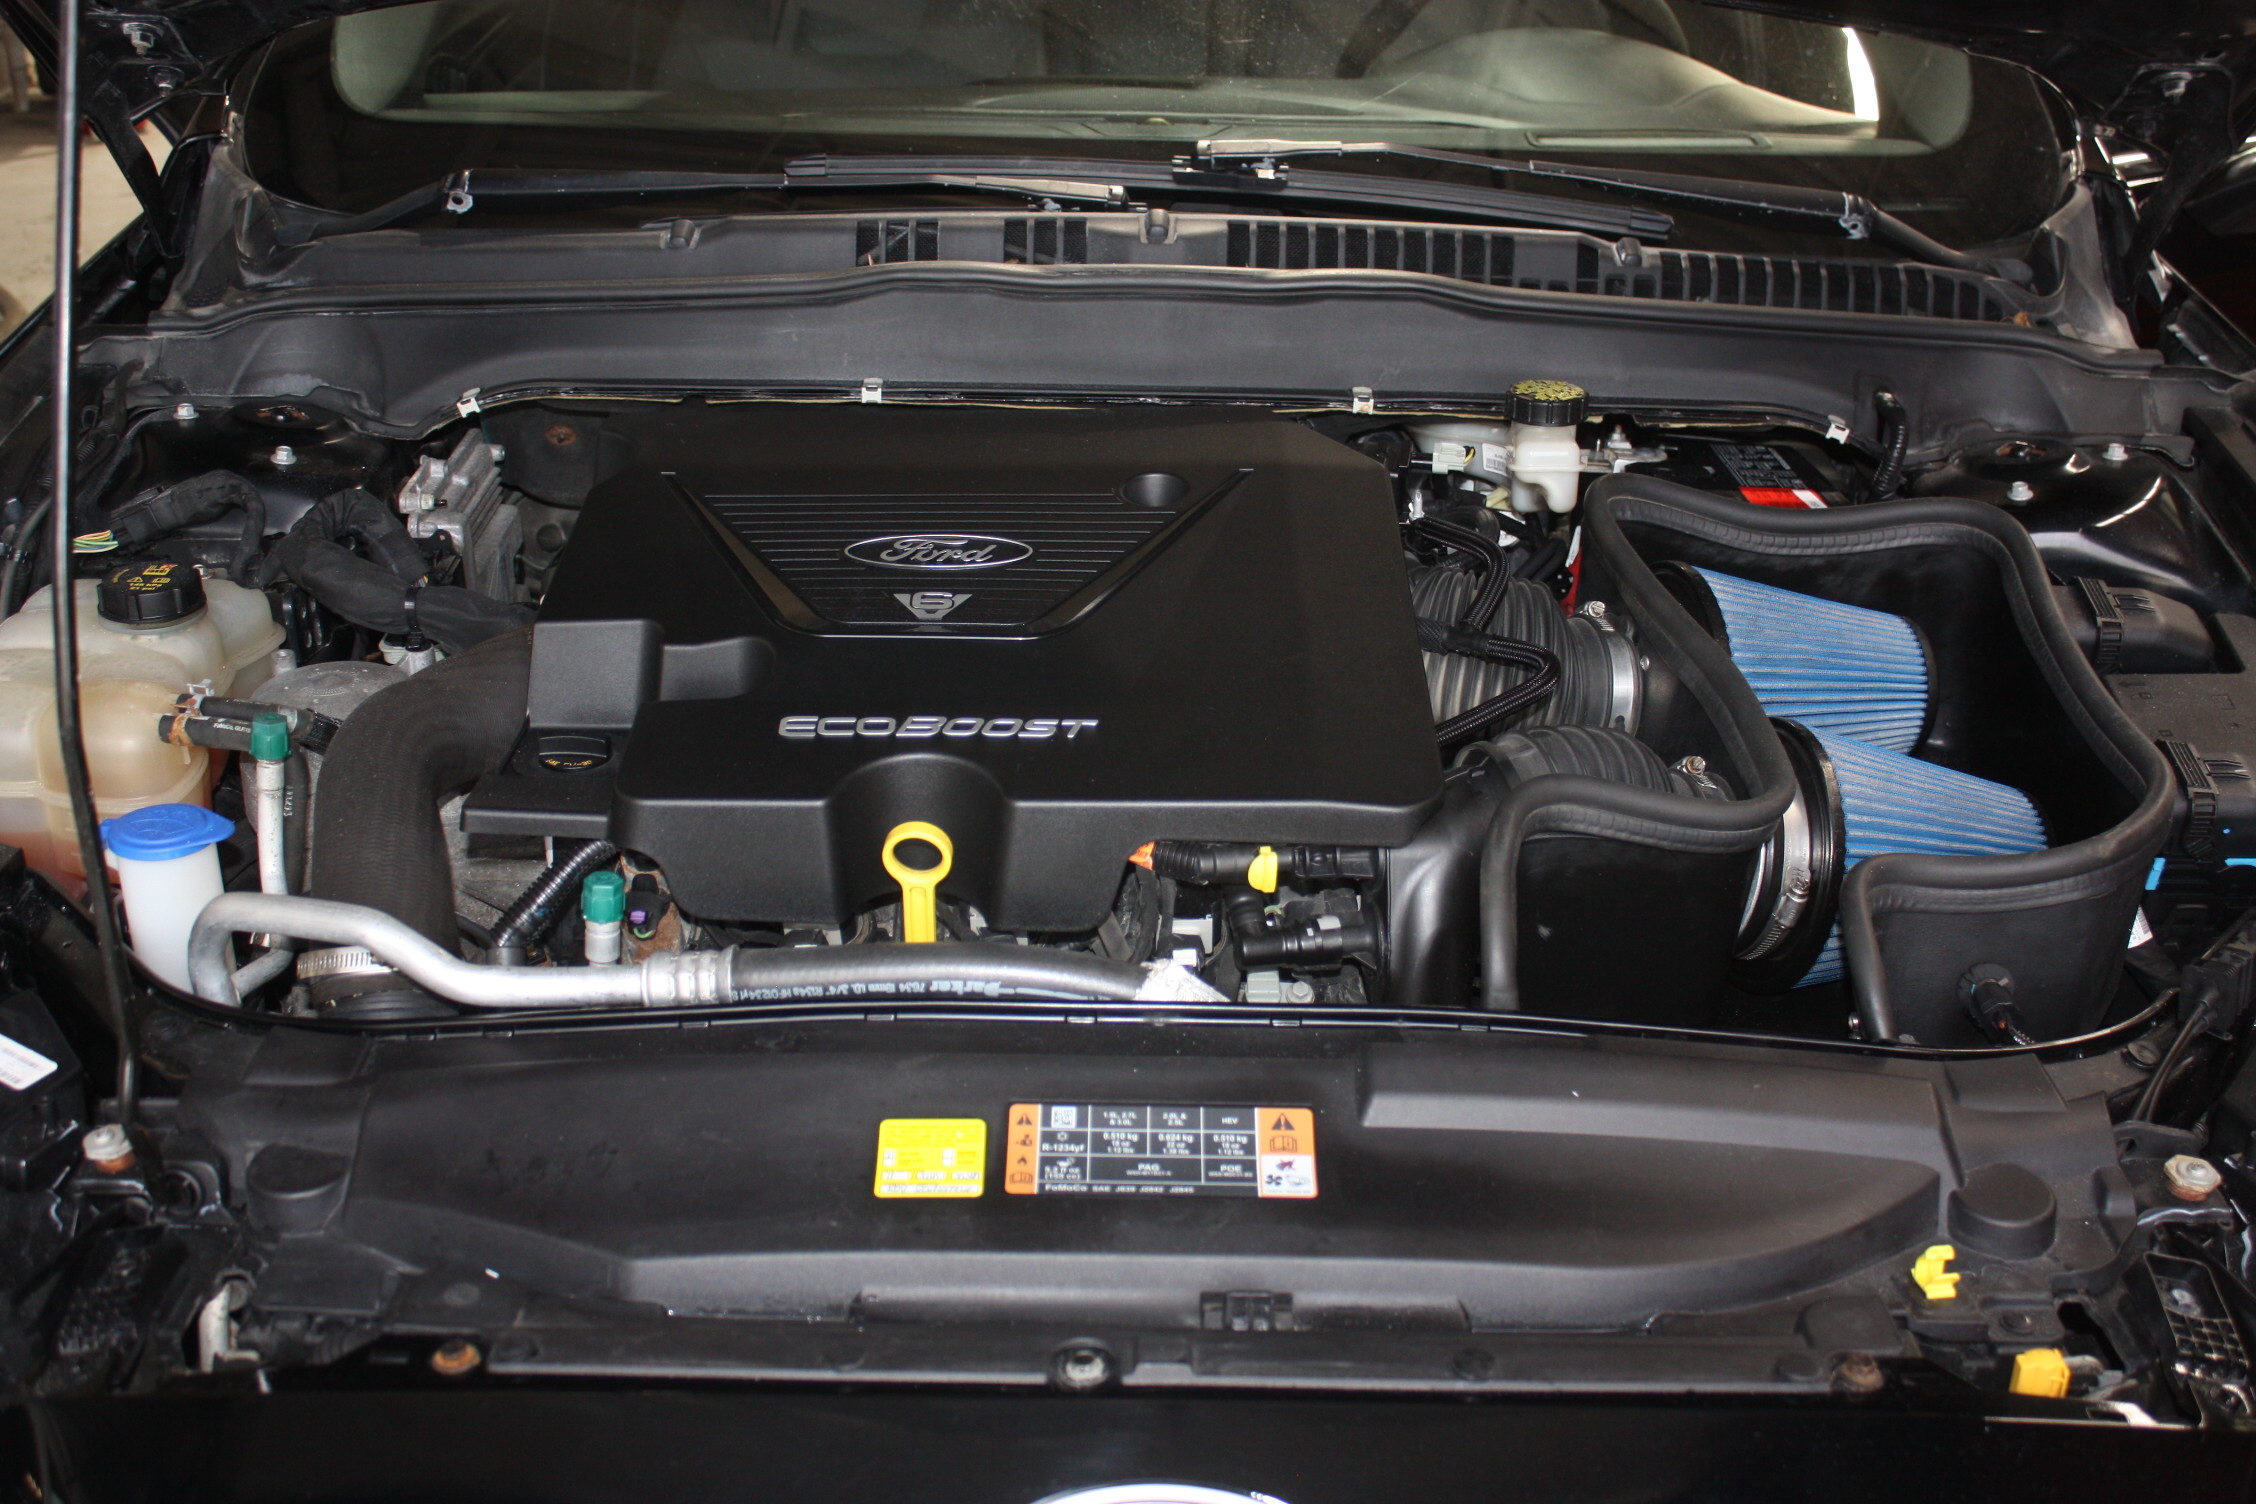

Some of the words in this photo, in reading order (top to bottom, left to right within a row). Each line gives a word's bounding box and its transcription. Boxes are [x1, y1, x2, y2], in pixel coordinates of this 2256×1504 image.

[880, 538, 996, 563] Ford
[930, 980, 1001, 997] Parker
[1103, 1133, 1126, 1141] 0.510
[1127, 1133, 1138, 1142] kg
[1182, 1134, 1194, 1143] kg
[1213, 1134, 1235, 1142] 0.510
[1236, 1134, 1248, 1144] kg
[1041, 1143, 1085, 1153] R-1234yf
[1138, 1163, 1160, 1171] PAG
[1220, 1164, 1242, 1172] POE
[1045, 1183, 1088, 1192] FoMoCo
